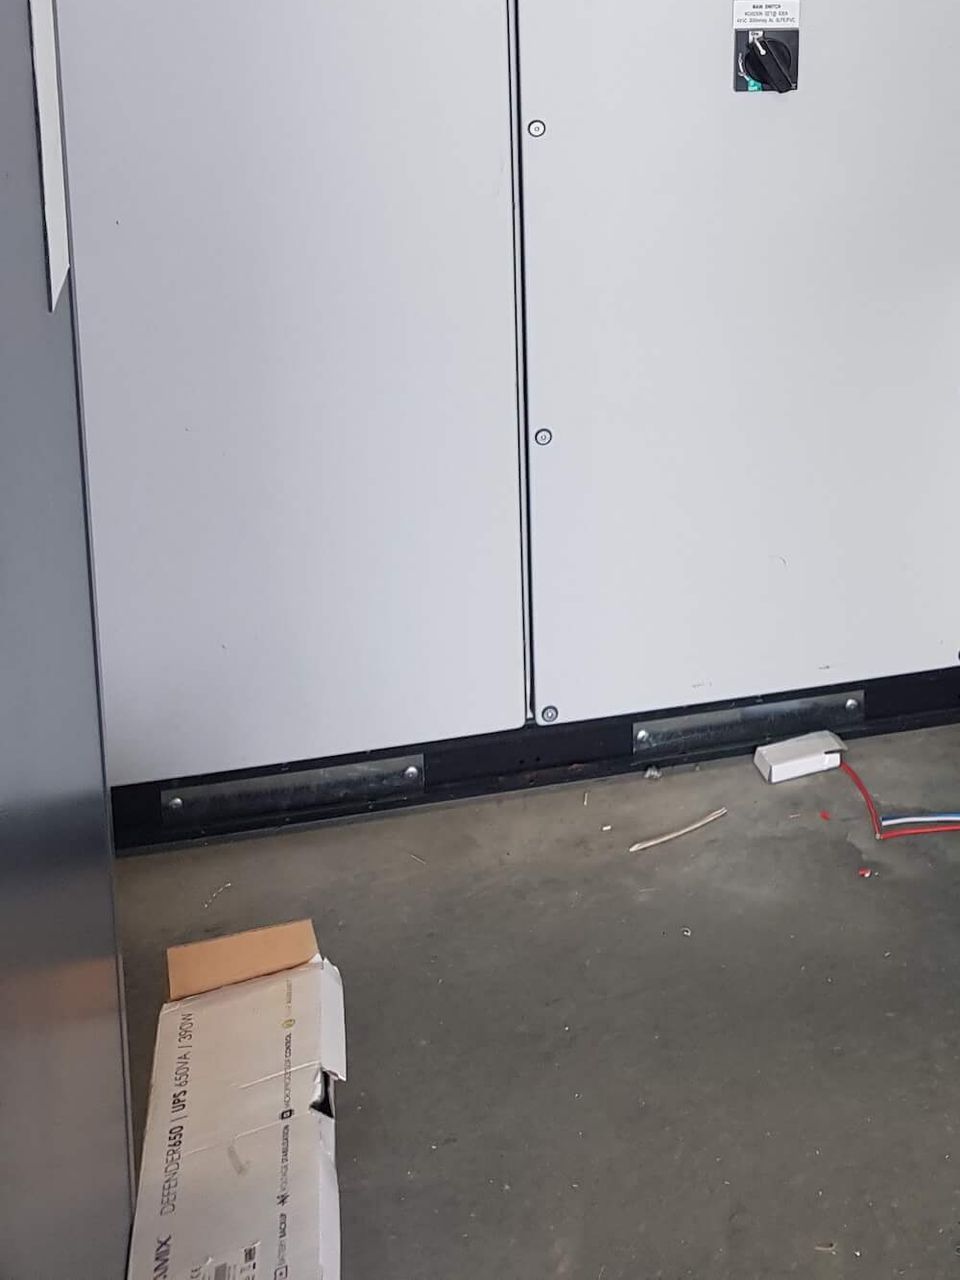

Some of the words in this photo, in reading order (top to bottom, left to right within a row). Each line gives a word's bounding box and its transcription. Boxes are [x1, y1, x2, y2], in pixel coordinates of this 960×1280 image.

[178, 1013, 194, 1043] 390W
[174, 1051, 191, 1088] 650VA
[171, 1090, 187, 1114] UPS
[160, 1125, 184, 1218] DEFENDER650
